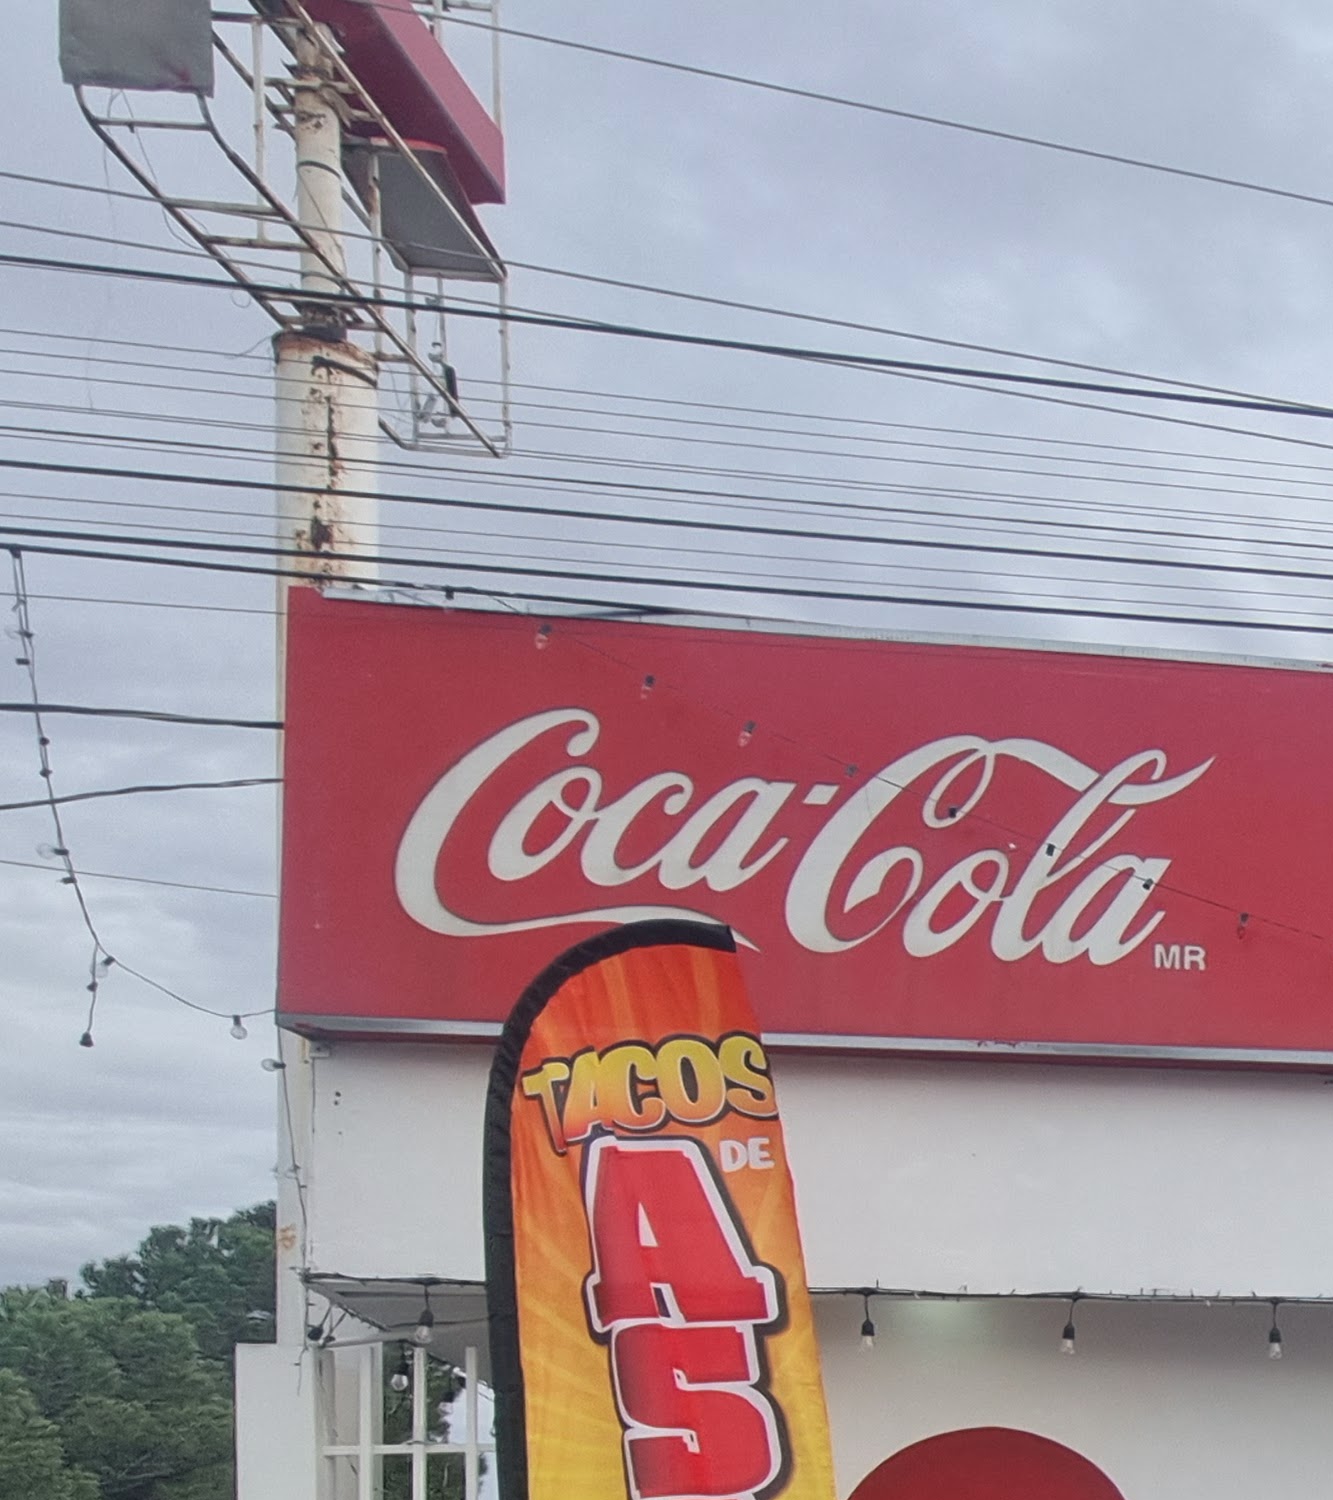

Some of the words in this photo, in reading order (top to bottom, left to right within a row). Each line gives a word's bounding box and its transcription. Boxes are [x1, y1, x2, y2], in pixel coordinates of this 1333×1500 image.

[396, 709, 1215, 966] Coca-Cola
[1154, 945, 1207, 971] MR
[521, 1035, 778, 1153] TACOS
[719, 1136, 775, 1172] DE
